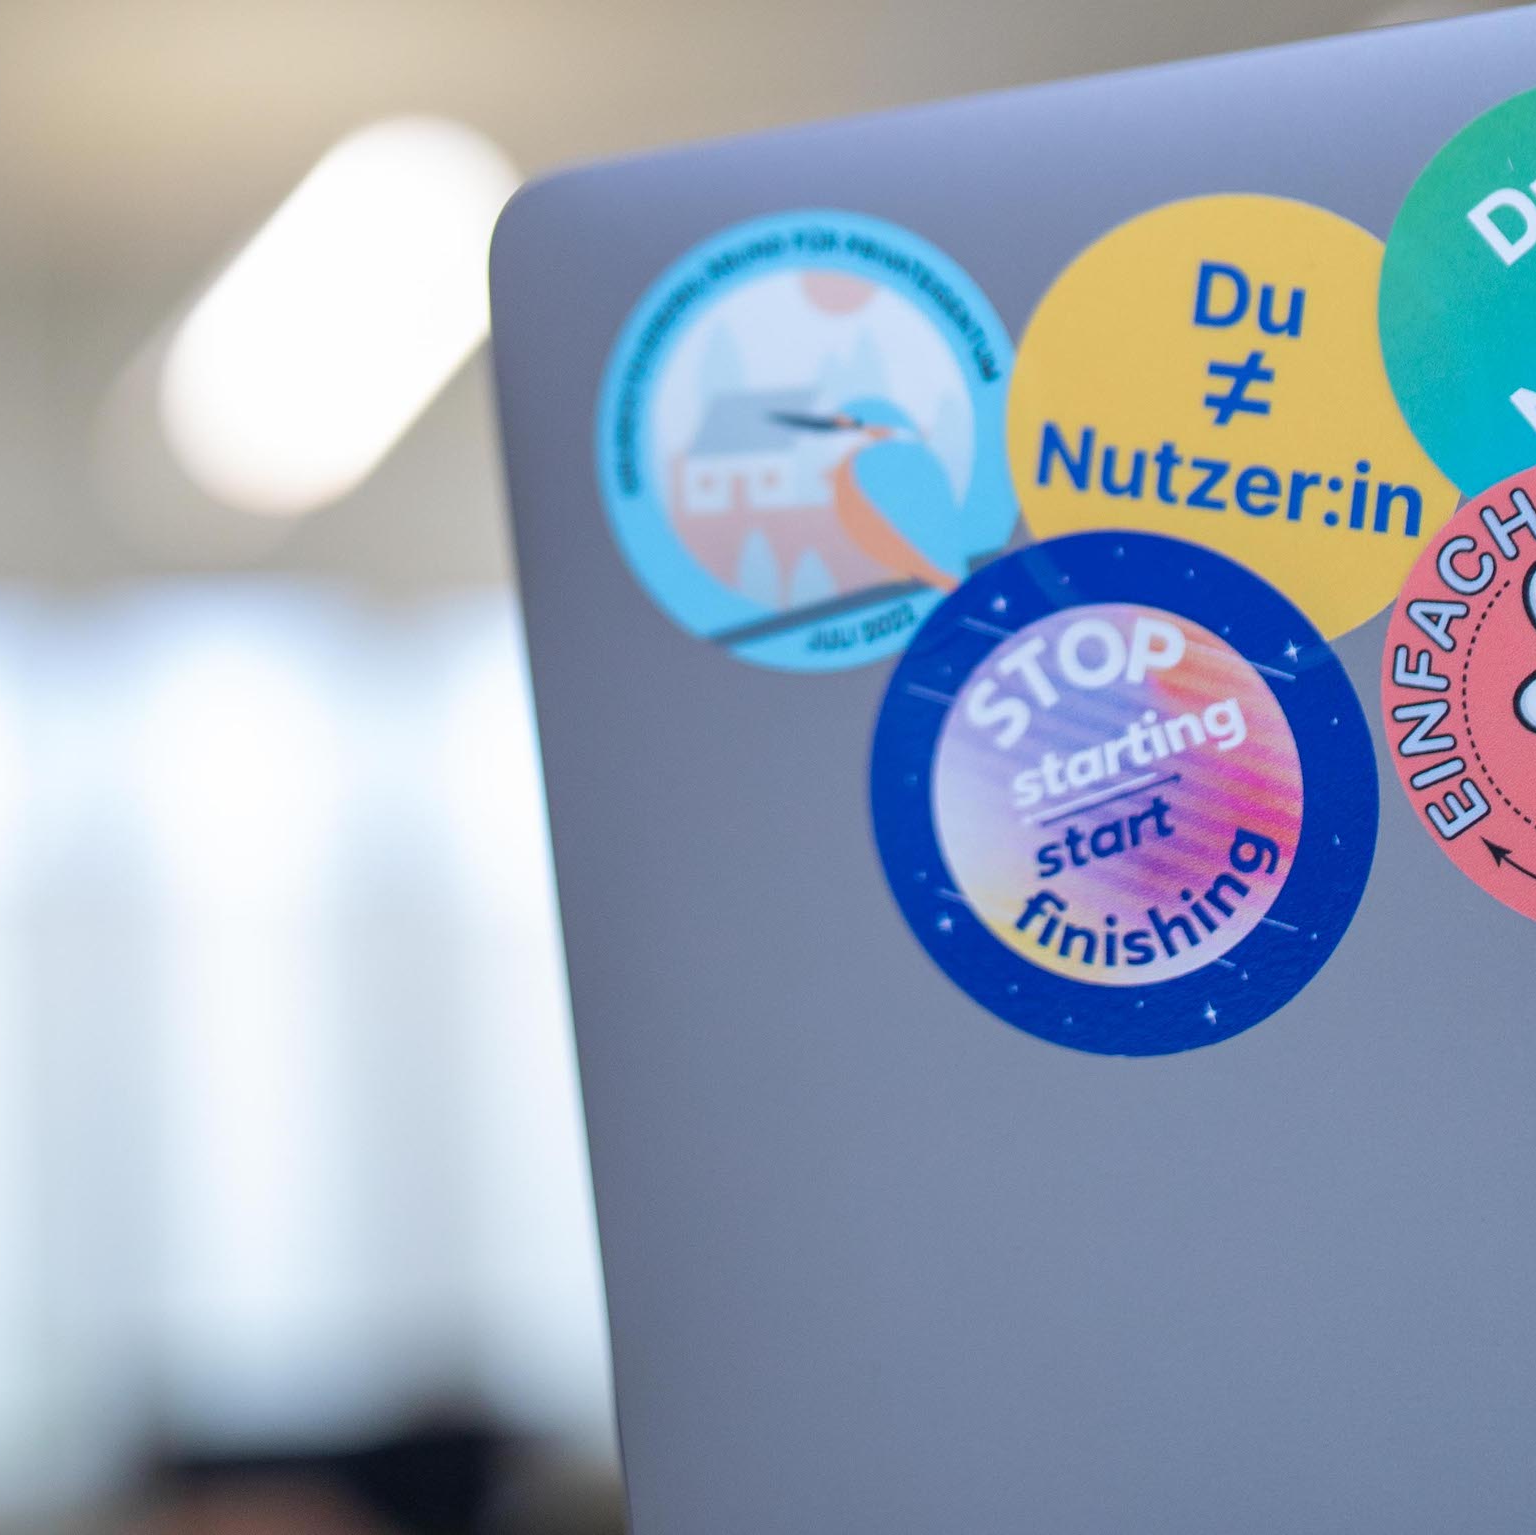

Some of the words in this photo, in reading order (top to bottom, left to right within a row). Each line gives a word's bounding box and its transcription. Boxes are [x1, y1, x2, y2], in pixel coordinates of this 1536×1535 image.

[1193, 259, 1305, 339] Du
[1035, 421, 1423, 538] Nutzer:in
[966, 616, 1186, 750] STOP
[1012, 697, 1248, 808] starting
[1036, 796, 1174, 878] start
[1013, 826, 1281, 968] finishing
